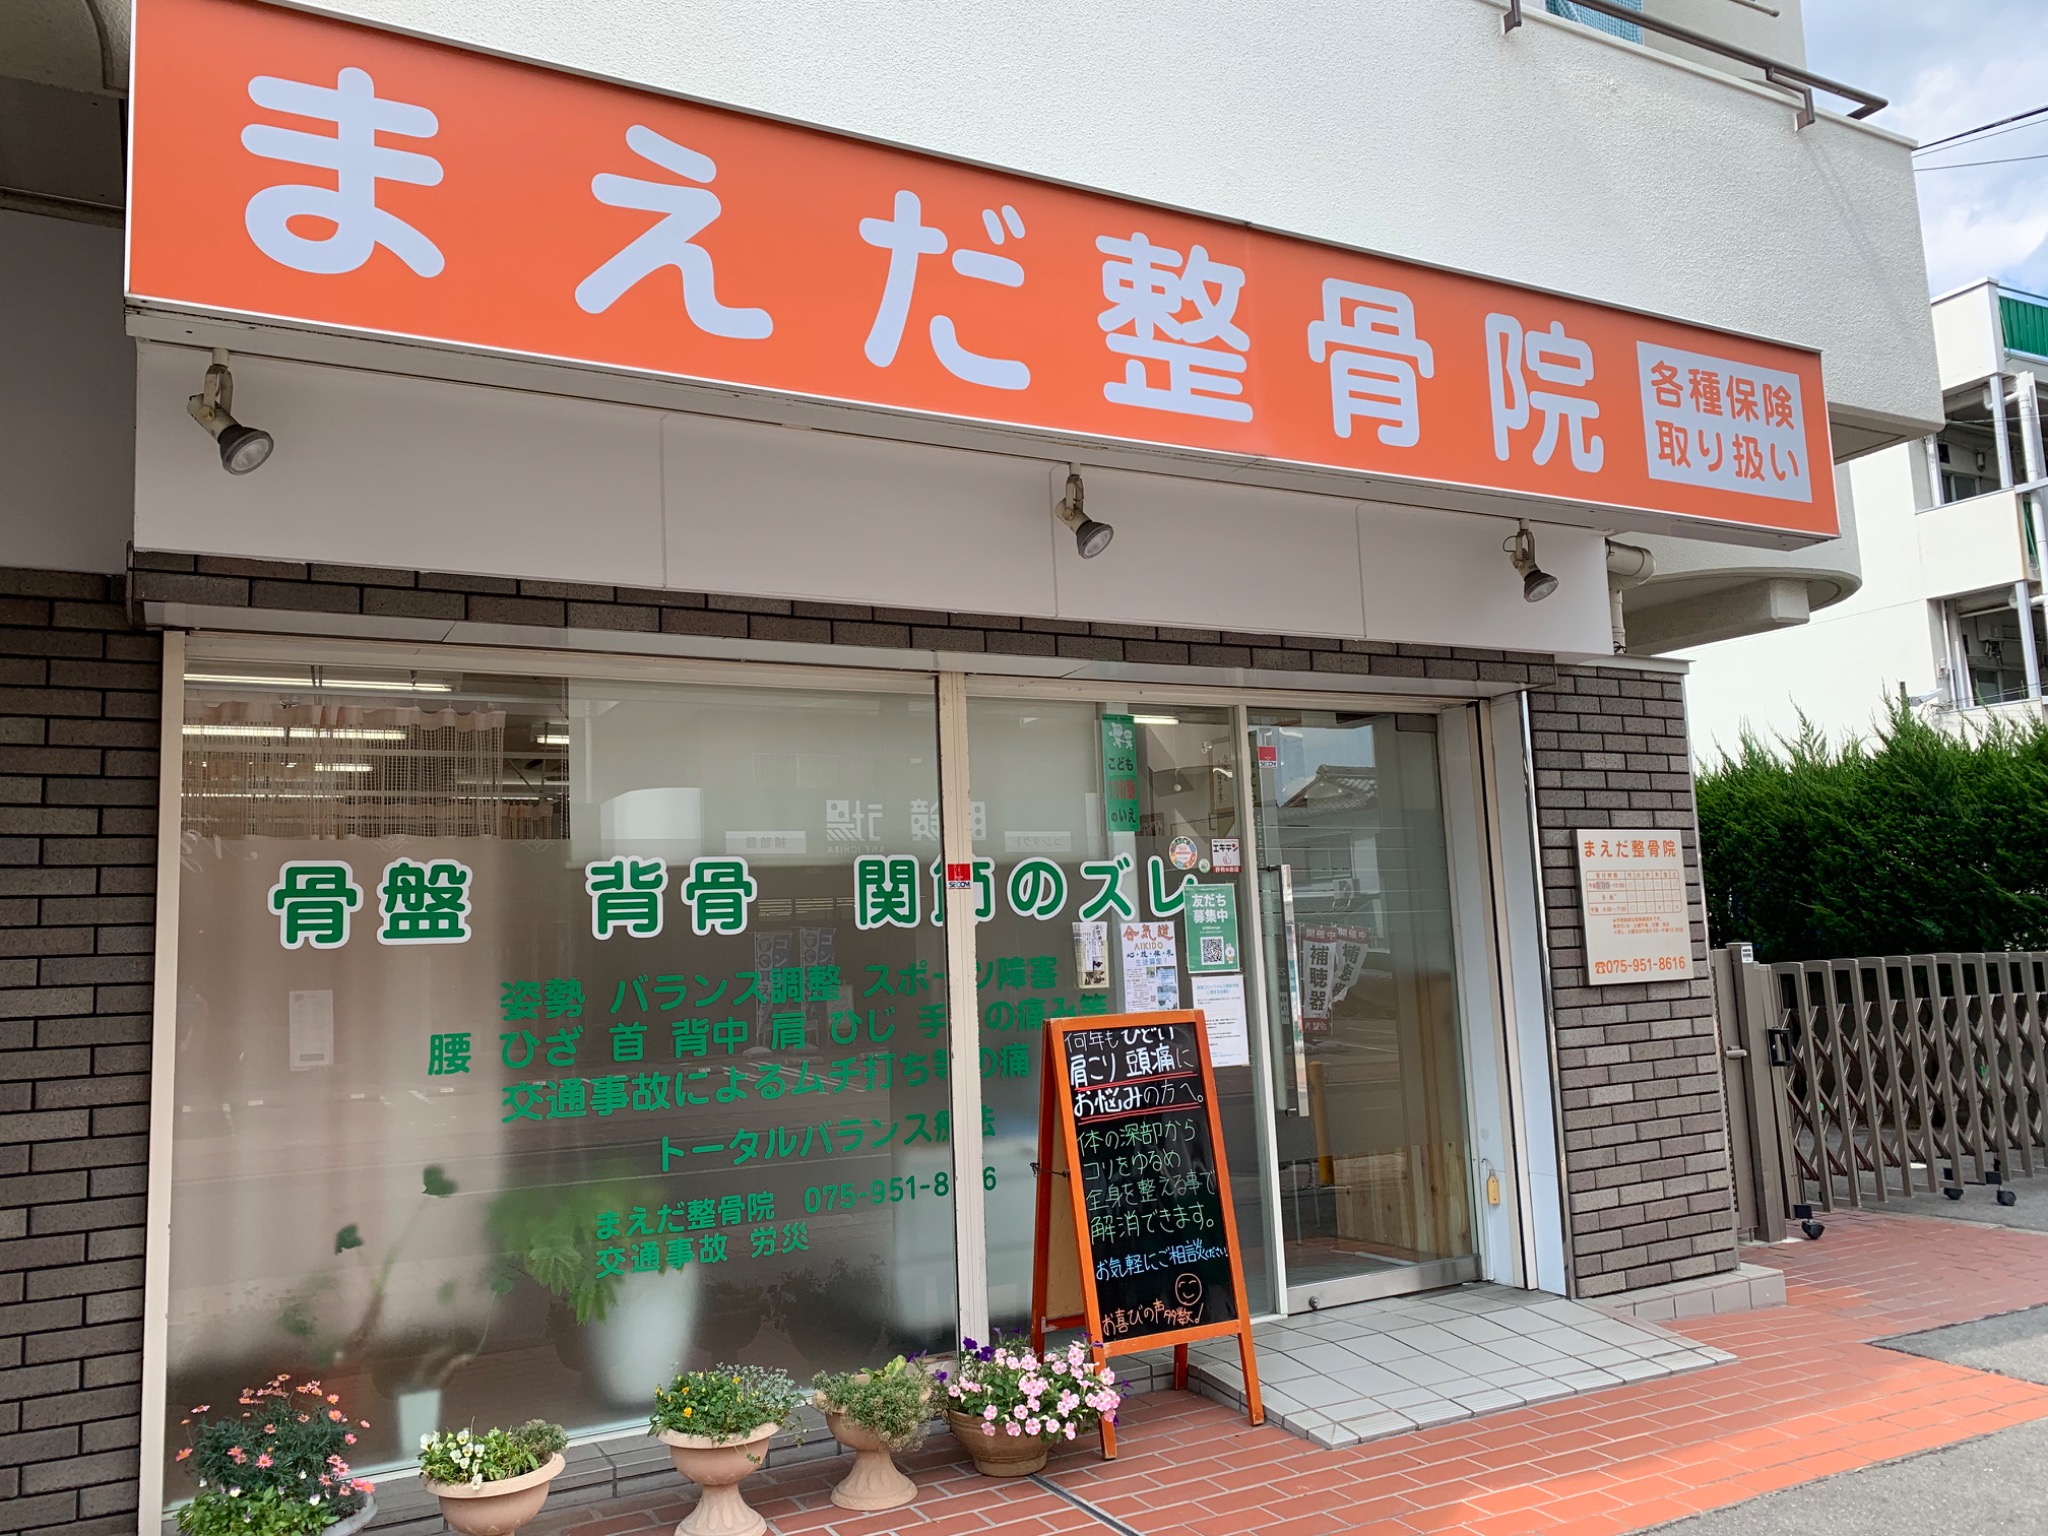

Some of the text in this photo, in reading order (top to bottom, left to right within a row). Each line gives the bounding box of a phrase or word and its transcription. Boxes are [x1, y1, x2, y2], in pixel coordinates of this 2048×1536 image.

[241, 66, 1604, 474] まえだ整骨院
[1650, 359, 1795, 432] 各種保険
[1657, 420, 1799, 483] 取り扱い
[1108, 757, 1134, 771] こども
[1110, 808, 1137, 823] のいえ
[1584, 840, 1676, 858] まえだ整骨院
[269, 858, 472, 950] 骨盤
[585, 854, 756, 941] 背骨
[1192, 893, 1227, 907] 友だち
[1193, 908, 1229, 924] 募集中
[1134, 942, 1164, 951] AIKIDO
[1606, 957, 1686, 973] 075-951-8616
[500, 977, 586, 1021] 姿勢
[608, 964, 842, 1014] バランス調整
[1309, 944, 1330, 1011] 補聴器
[428, 992, 1109, 1076] 腰 ひざ 首 背中 肩 ひじ 手の痛み等
[1070, 1043, 1195, 1087] 肩こり 頭痛に
[1074, 1080, 1204, 1117] お悩みの方へ。
[1077, 1118, 1196, 1156] 体の深部から
[1084, 1149, 1181, 1180] コリをゆるめ
[595, 1166, 997, 1240] まえだ整骨院 075-951-86
[1086, 1169, 1215, 1211] 全身を整える事で
[1091, 1202, 1214, 1245] 解消できます。
[595, 1221, 810, 1279] 交通事故 労災
